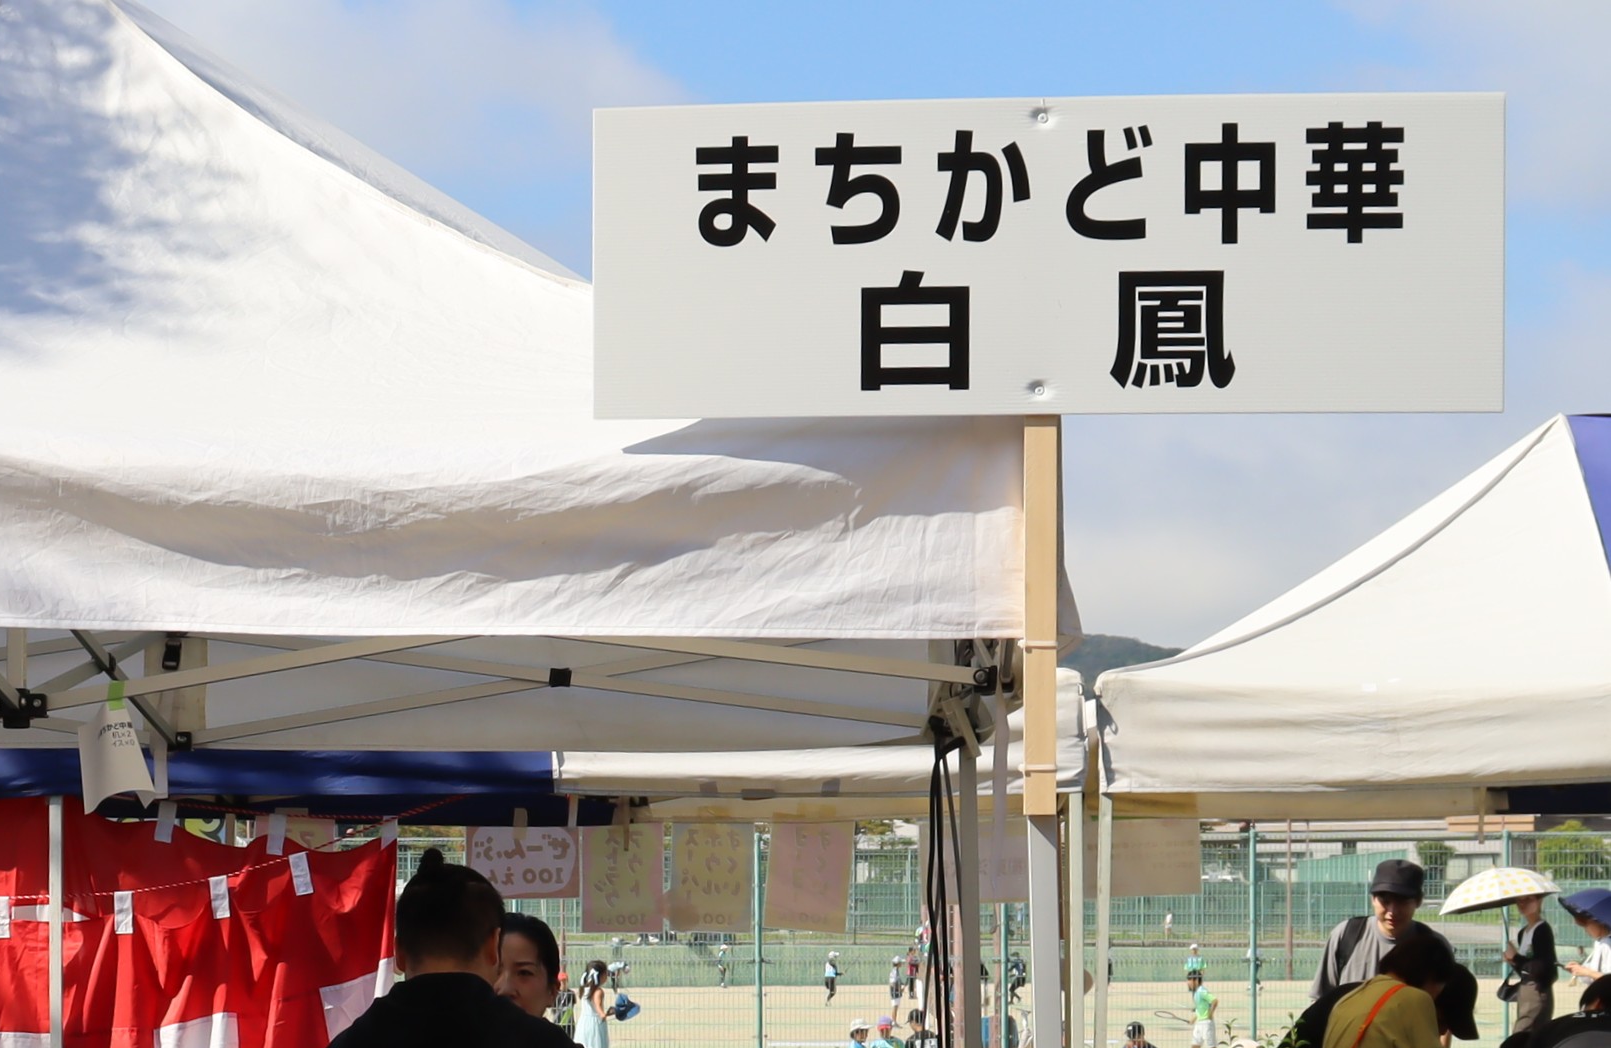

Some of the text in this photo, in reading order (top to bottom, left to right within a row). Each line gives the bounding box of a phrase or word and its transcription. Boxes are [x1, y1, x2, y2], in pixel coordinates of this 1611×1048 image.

[694, 121, 1406, 247] まちかど中華
[860, 270, 1236, 391] 白鳳
